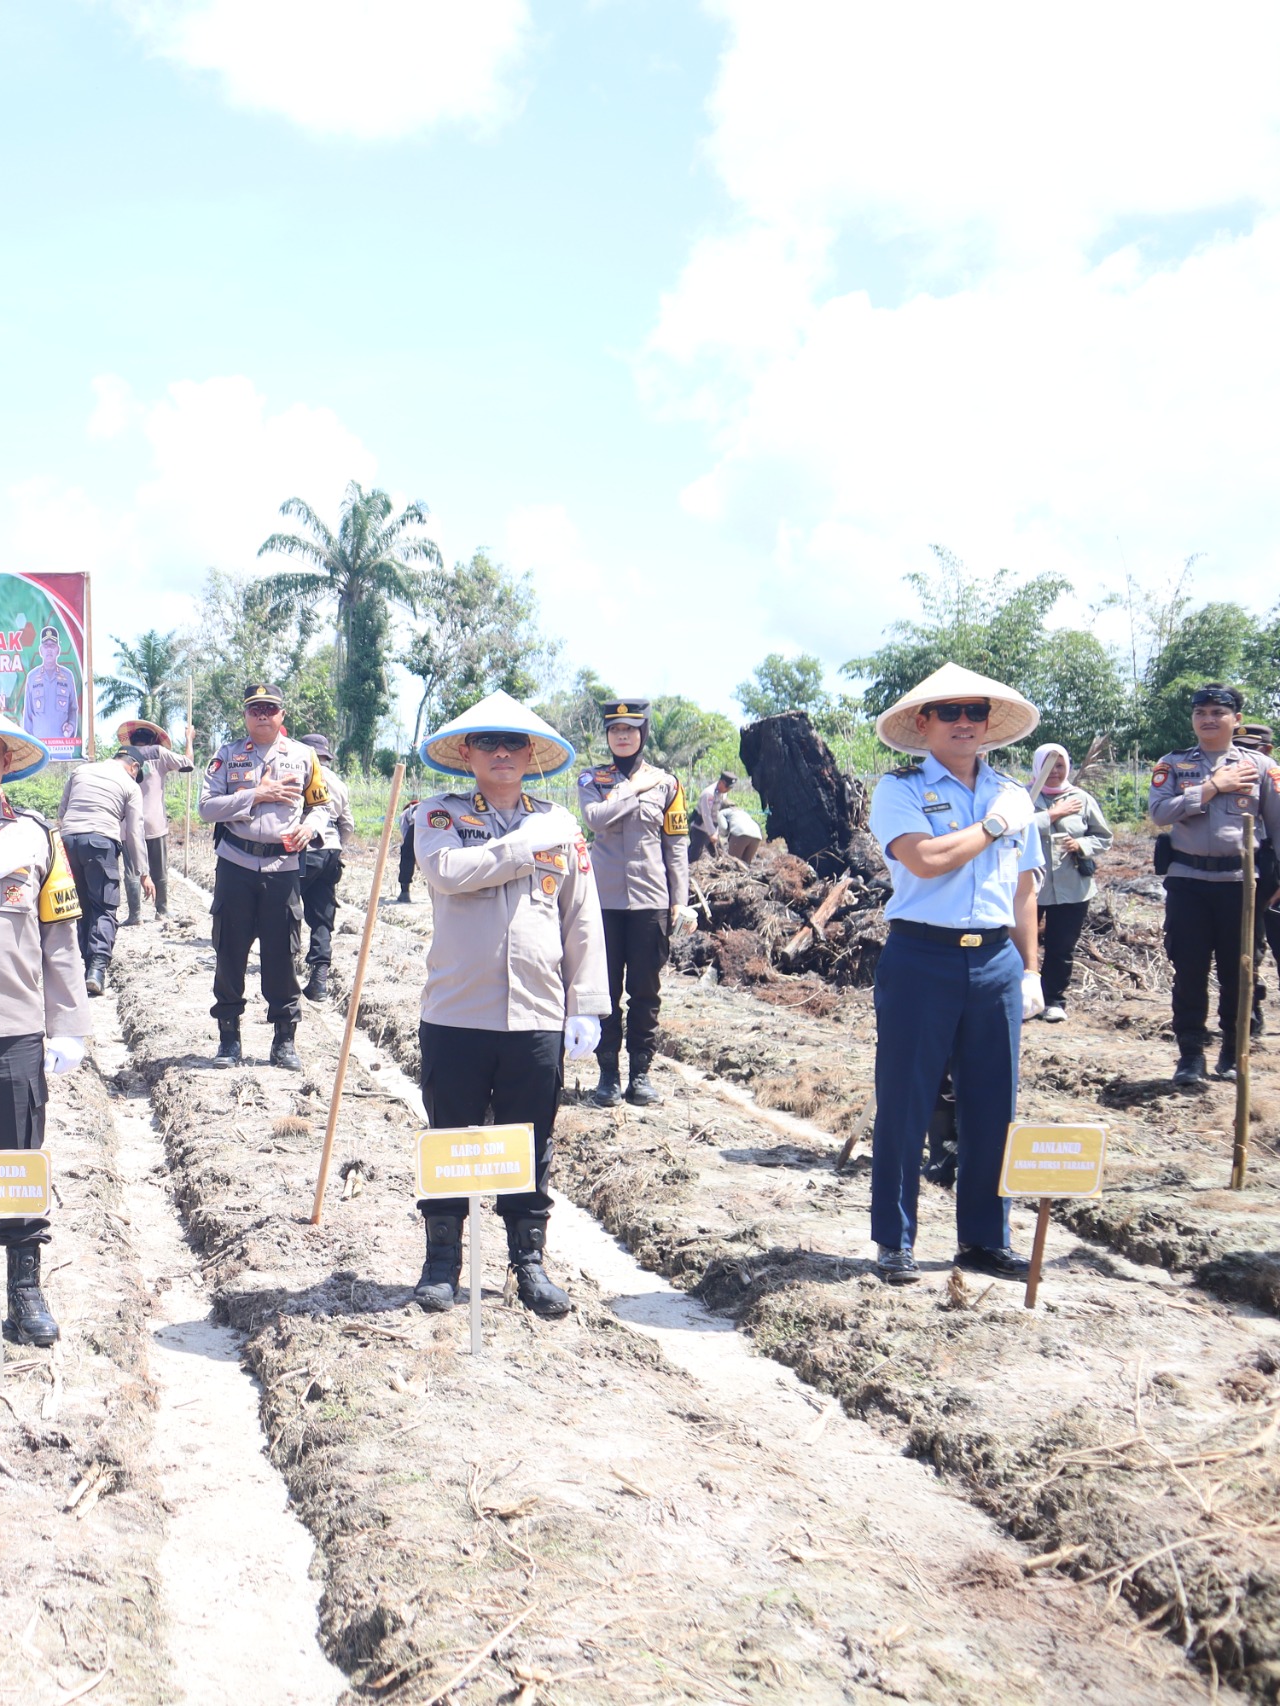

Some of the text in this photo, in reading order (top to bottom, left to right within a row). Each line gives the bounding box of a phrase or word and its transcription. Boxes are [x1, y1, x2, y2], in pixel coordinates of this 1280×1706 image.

[280, 762, 303, 770] POLRI
[483, 1142, 505, 1155] SDM
[435, 1161, 521, 1178] POLDA KALTARA
[8, 1185, 43, 1198] UTARA
